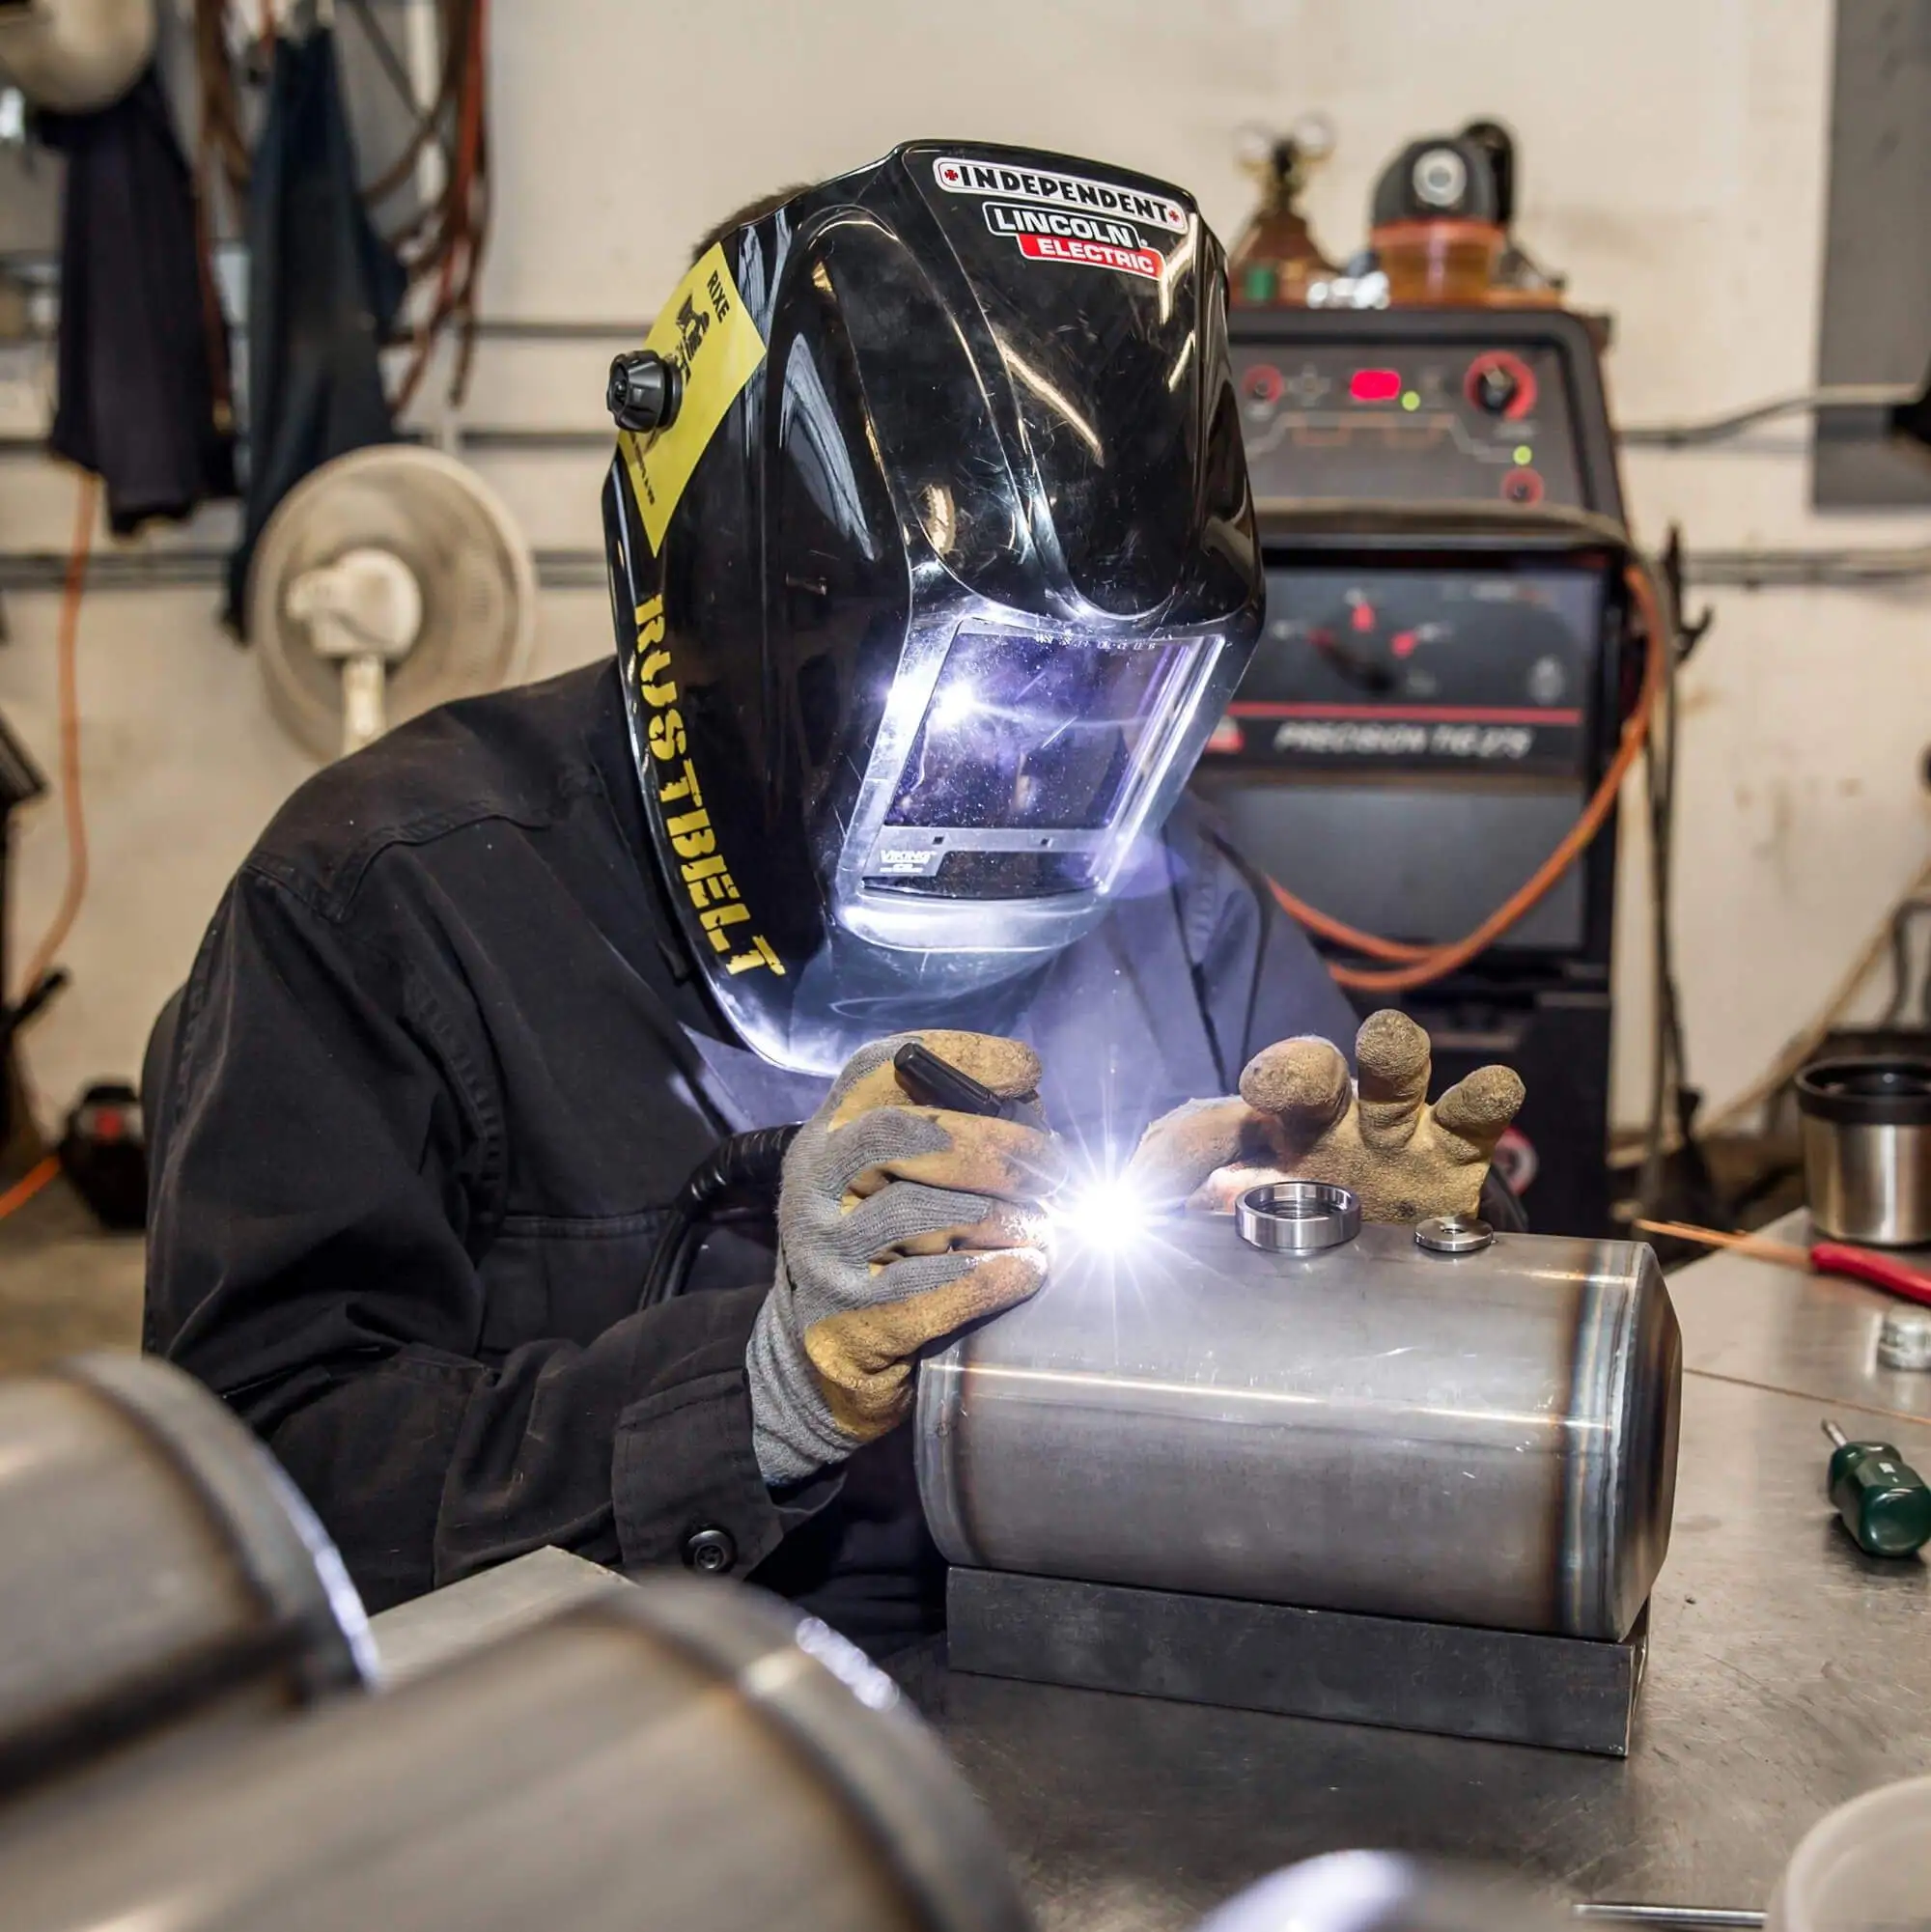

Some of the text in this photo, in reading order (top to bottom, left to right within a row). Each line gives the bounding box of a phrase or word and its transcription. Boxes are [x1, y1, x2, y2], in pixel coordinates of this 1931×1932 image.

[960, 165, 1168, 222] INDEPENDENT
[993, 209, 1130, 247] LINCOLN
[1037, 238, 1155, 272] ELECTRIC
[706, 270, 730, 323] RIXE
[634, 594, 786, 976] RUSTBELT
